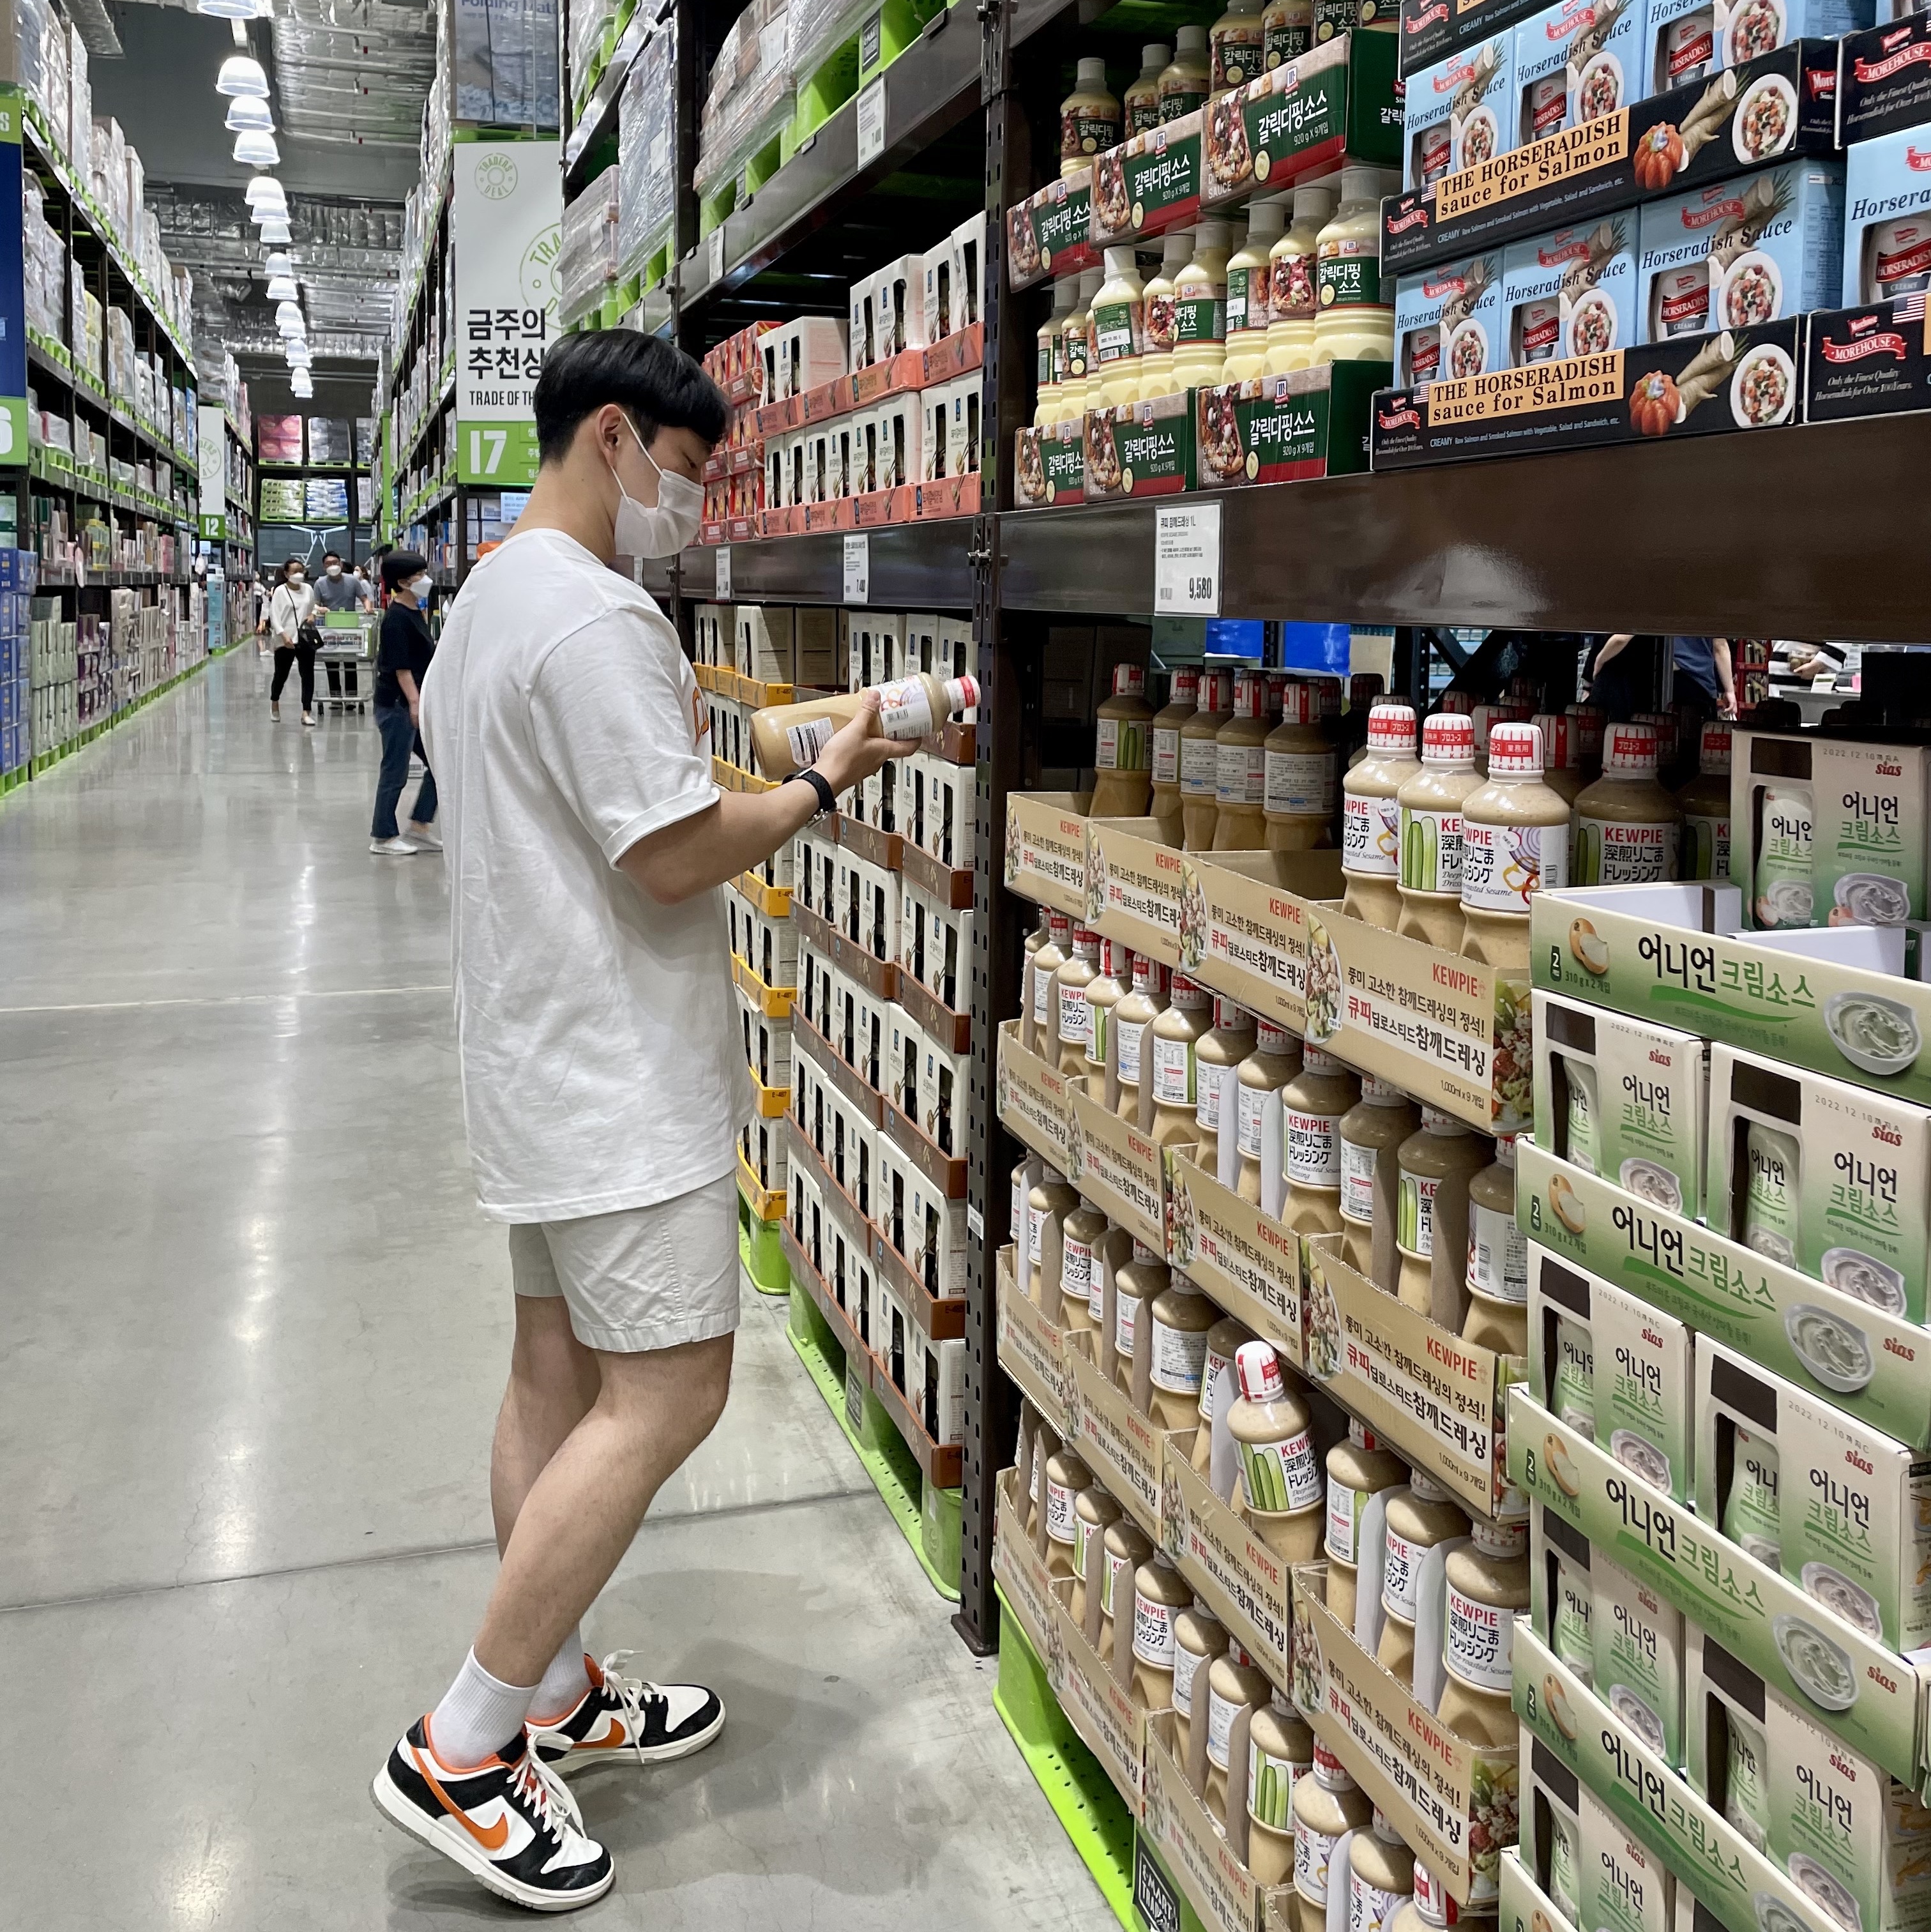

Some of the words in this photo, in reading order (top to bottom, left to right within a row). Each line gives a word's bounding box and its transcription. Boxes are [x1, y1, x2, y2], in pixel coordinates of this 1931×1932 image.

[1459, 17, 1482, 34] CREAMY
[1518, 40, 1586, 81] Horseradish
[1592, 19, 1632, 47] Sauce
[1867, 45, 1925, 80] MOREHOUSE
[1259, 89, 1328, 145] 갈릭디핑소스
[1407, 95, 1467, 130] Horseradish
[1472, 77, 1505, 102] Sauce
[1294, 133, 1305, 146] 920
[1442, 172, 1474, 196] THE
[1481, 114, 1621, 179] HORSERADISH
[1135, 154, 1190, 198] 갈릭디핑소스
[1208, 180, 1232, 199] SAUCE
[1441, 186, 1491, 216] sauce
[1499, 171, 1529, 195] for
[1538, 141, 1621, 181] Salmon
[1438, 229, 1460, 243] CREAMY
[1615, 177, 1624, 186] etc.
[1691, 202, 1739, 227] MOREHOUSE
[1543, 245, 1582, 267] MOREHOUSE
[1642, 230, 1733, 270] Horseradish
[1740, 219, 1792, 250] Sauce
[1319, 263, 1361, 284] 갈릭디핑
[1338, 280, 1361, 294] 소스
[1505, 269, 1579, 302] Horseradish
[1586, 261, 1626, 283] Sauce
[467, 308, 546, 340] 금주의
[1180, 319, 1197, 333] 소스
[1397, 301, 1456, 329] Horseradish
[1462, 294, 1496, 314] Sauce
[468, 347, 545, 379] 추천상
[1835, 336, 1891, 360] MOREHOUSE
[1434, 383, 1467, 402] THE
[1474, 354, 1616, 397] HORSERADISH
[1828, 376, 1842, 388] Only
[1844, 374, 1855, 383] the
[1854, 373, 1874, 383] Finest
[1875, 368, 1901, 382] Quality
[1863, 385, 1879, 394] Over
[469, 391, 504, 406] TRADE
[508, 391, 519, 406] OF
[1434, 400, 1485, 421] sauce
[1494, 393, 1523, 412] for
[1533, 380, 1616, 407] Salmon
[1250, 409, 1315, 446] 갈릭디핑소스
[1385, 411, 1414, 428] MOREHOUSE
[1430, 437, 1452, 447] CREAMY
[1610, 416, 1620, 425] etc.
[471, 430, 507, 474] 17
[1124, 433, 1175, 464] 갈릭디핑소스
[1203, 472, 1224, 483] SAUCE
[205, 517, 218, 536] 12
[1190, 577, 1211, 600] 9,580
[1441, 733, 1462, 742] プロユース
[1508, 743, 1529, 754] 業務用
[1875, 761, 1902, 777] sias
[1842, 791, 1898, 825] 어니언
[1060, 820, 1080, 838] KEWPIE
[1604, 826, 1662, 843] KEWPIE
[1840, 821, 1901, 844] 크림소스
[1155, 852, 1181, 874] KEWPIE
[1359, 851, 1386, 861] Sesame
[1120, 867, 1135, 884] 고소한
[1137, 872, 1169, 897] 참깨드레싱의
[1603, 865, 1663, 883] ドレッシング
[1480, 887, 1513, 897] Sesame
[1211, 904, 1223, 922] 풍미
[1225, 911, 1244, 931] 고소한
[1246, 918, 1286, 948] 참깨드레싱의
[1269, 897, 1301, 924] KEWPIE
[1552, 952, 1559, 968] 2
[1433, 962, 1478, 998] KEWPIE
[1565, 971, 1578, 984] 310
[1348, 966, 1365, 989] 풍미
[1368, 975, 1395, 1000] 고소한
[1398, 986, 1456, 1027] 참깨드레싱의
[1460, 1011, 1485, 1038] 정석!
[1649, 1049, 1671, 1067] sias
[1441, 1079, 1460, 1097] 1,000ml
[1472, 1093, 1484, 1109] 개입
[1623, 1074, 1670, 1116] 어니언
[1289, 1114, 1329, 1133] KEWPIE
[1623, 1103, 1673, 1136] 크림소스
[1872, 1125, 1903, 1146] sias
[1751, 1148, 1785, 1187] 어니언
[1834, 1152, 1897, 1203] 어니언
[1533, 1201, 1540, 1218] 2
[1830, 1183, 1898, 1226] 크림소스
[1199, 1209, 1211, 1228] 풍미
[1213, 1220, 1232, 1245] 고소한
[1234, 1235, 1275, 1277] 참깨드레싱의
[1257, 1221, 1289, 1256] KEWPIE
[1641, 1328, 1663, 1348] sias
[1882, 1335, 1915, 1362] sias
[1345, 1314, 1363, 1341] 풍미
[1365, 1328, 1391, 1360] 고소한
[1394, 1348, 1451, 1403] 참깨드레싱의
[1455, 1388, 1486, 1422] 정석!
[1427, 1335, 1477, 1381] KEWPIE
[1616, 1348, 1660, 1396] 어니언
[1614, 1374, 1663, 1417] 크림소스
[1439, 1452, 1458, 1474] 1,000ml
[1470, 1472, 1486, 1492] 개입
[1845, 1450, 1874, 1475] sias
[1810, 1469, 1869, 1530] 어니언
[1807, 1498, 1872, 1554] 크림소스
[1246, 1540, 1278, 1585] KEWPIE
[1136, 1597, 1167, 1620] KEWPIE
[1450, 1592, 1498, 1627] KEWPIE
[1637, 1589, 1658, 1615] sias
[1614, 1603, 1657, 1661] 어니언
[1614, 1638, 1658, 1682] 크림소스
[1867, 1665, 1898, 1694] sias
[1328, 1659, 1345, 1686] 풍미
[1347, 1679, 1372, 1719] 고소한
[1375, 1710, 1430, 1781] 참깨드레싱의
[1434, 1768, 1460, 1808] 정석!
[1408, 1707, 1452, 1767] KEWPIE
[1829, 1753, 1856, 1783] sias
[1796, 1763, 1852, 1833] 어니언
[1794, 1793, 1853, 1847] 크림소스
[1625, 1842, 1646, 1869] sias
[1602, 1851, 1644, 1913] 어니언
[1600, 1885, 1645, 1932] 크림소스
